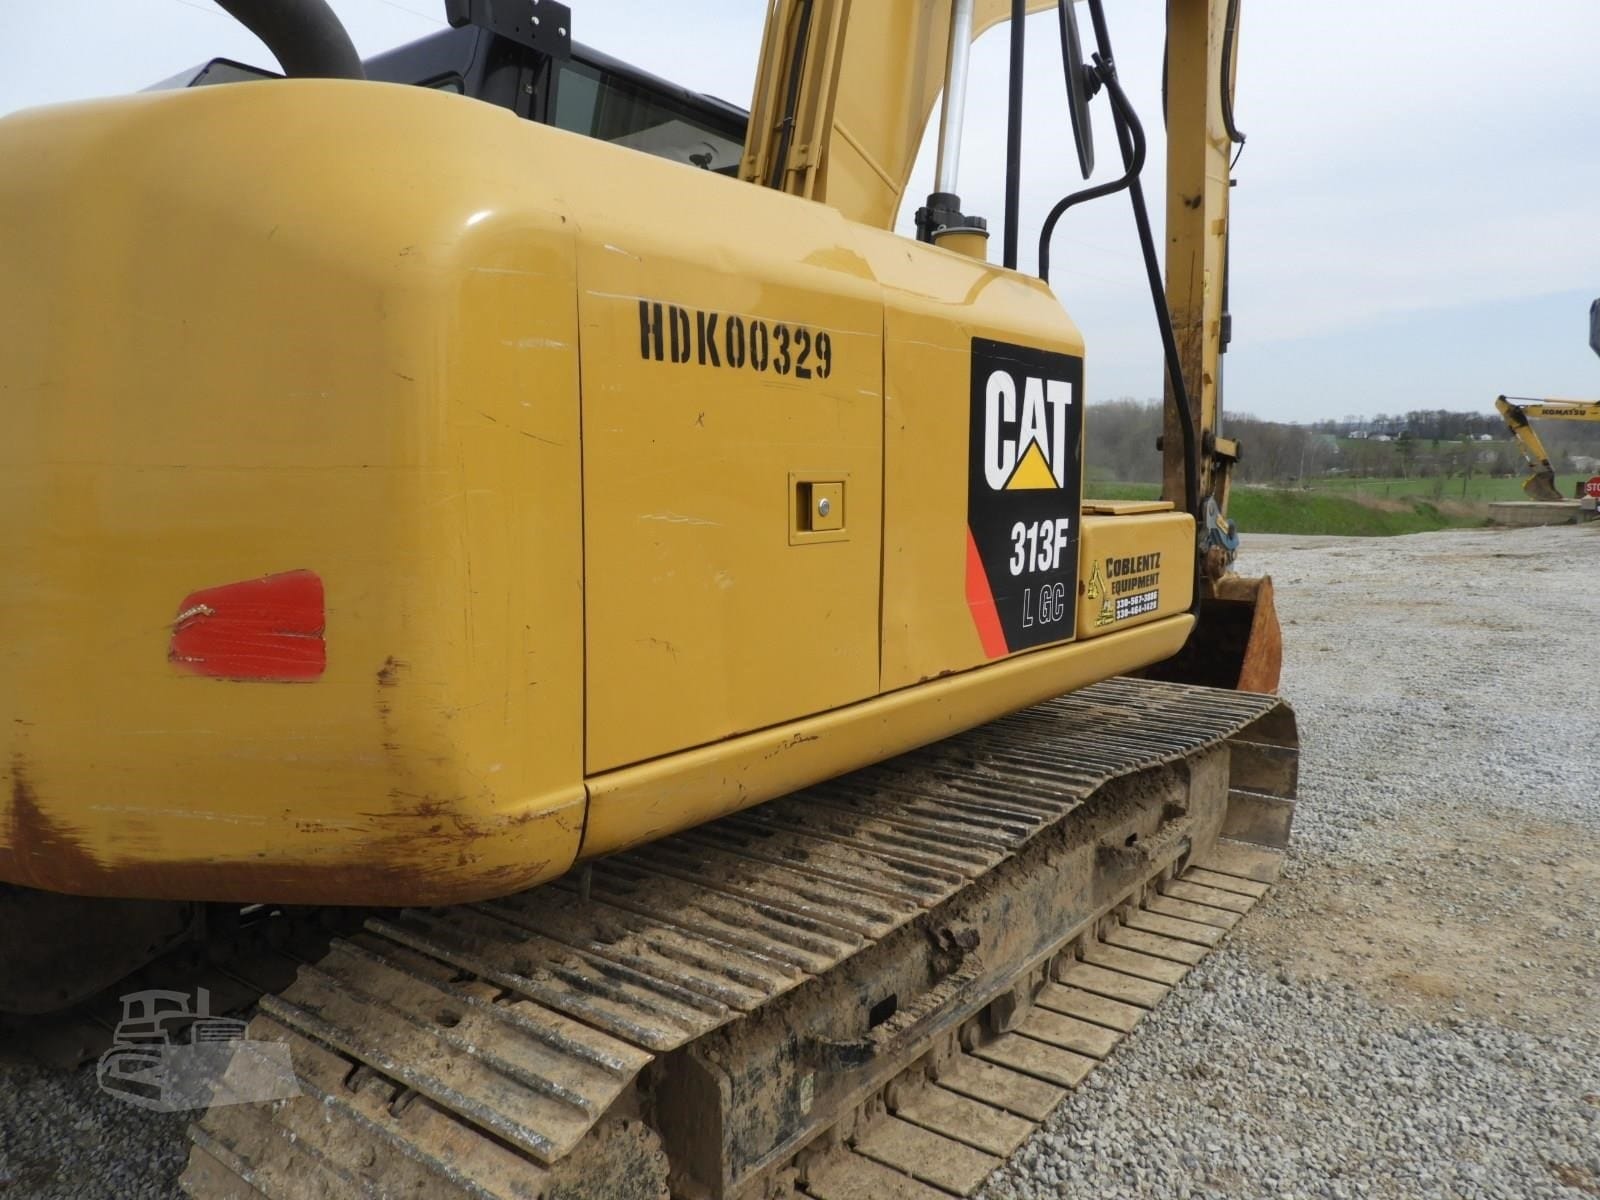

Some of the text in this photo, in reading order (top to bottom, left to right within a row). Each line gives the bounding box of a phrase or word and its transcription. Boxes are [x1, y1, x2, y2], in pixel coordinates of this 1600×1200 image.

[639, 300, 832, 379] HDK00329
[984, 370, 1073, 491] CAT
[1541, 408, 1586, 416] KOMATSU
[1009, 518, 1069, 576] 313F
[1106, 552, 1161, 578] COBLENTZ
[1022, 582, 1065, 629] L GC
[1111, 573, 1160, 595] EQUIPMENT
